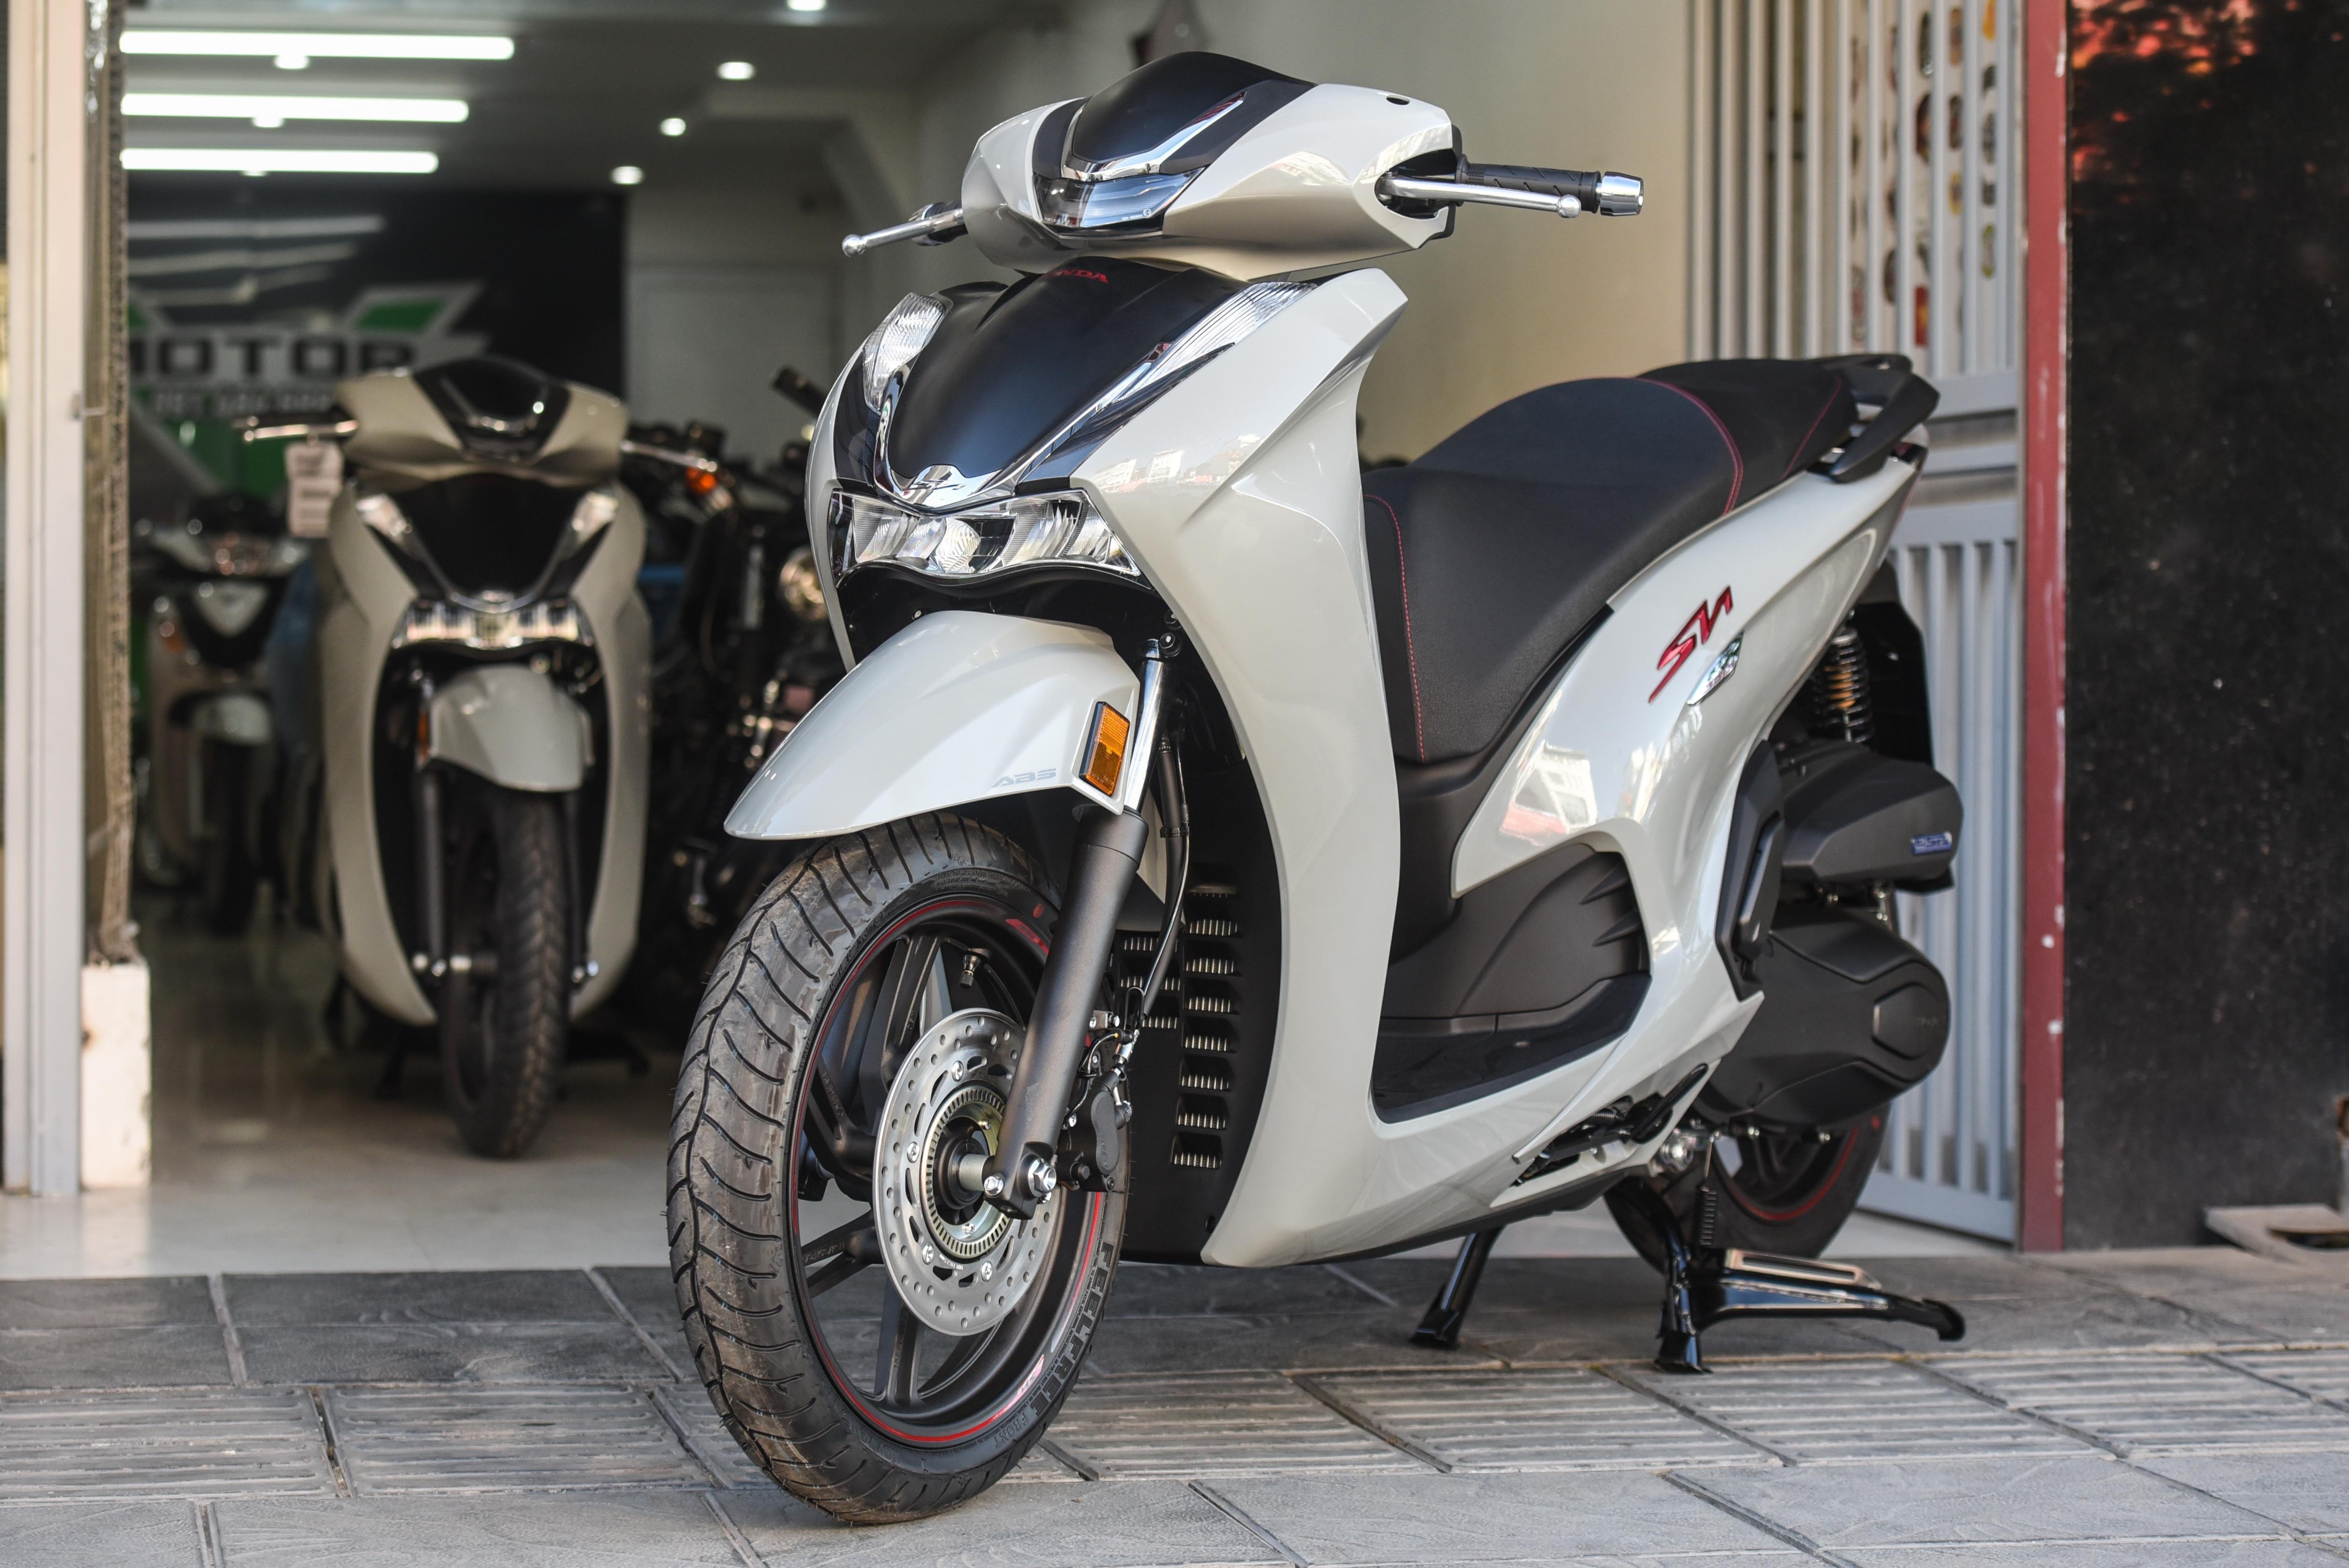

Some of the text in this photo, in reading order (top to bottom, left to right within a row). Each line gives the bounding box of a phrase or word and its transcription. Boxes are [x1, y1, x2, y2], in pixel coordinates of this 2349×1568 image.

[1043, 268, 1109, 283] NDA
[991, 768, 1057, 789] ABS
[1030, 1241, 1115, 1417] FEELFREE
[994, 1412, 1028, 1449] FRONT
